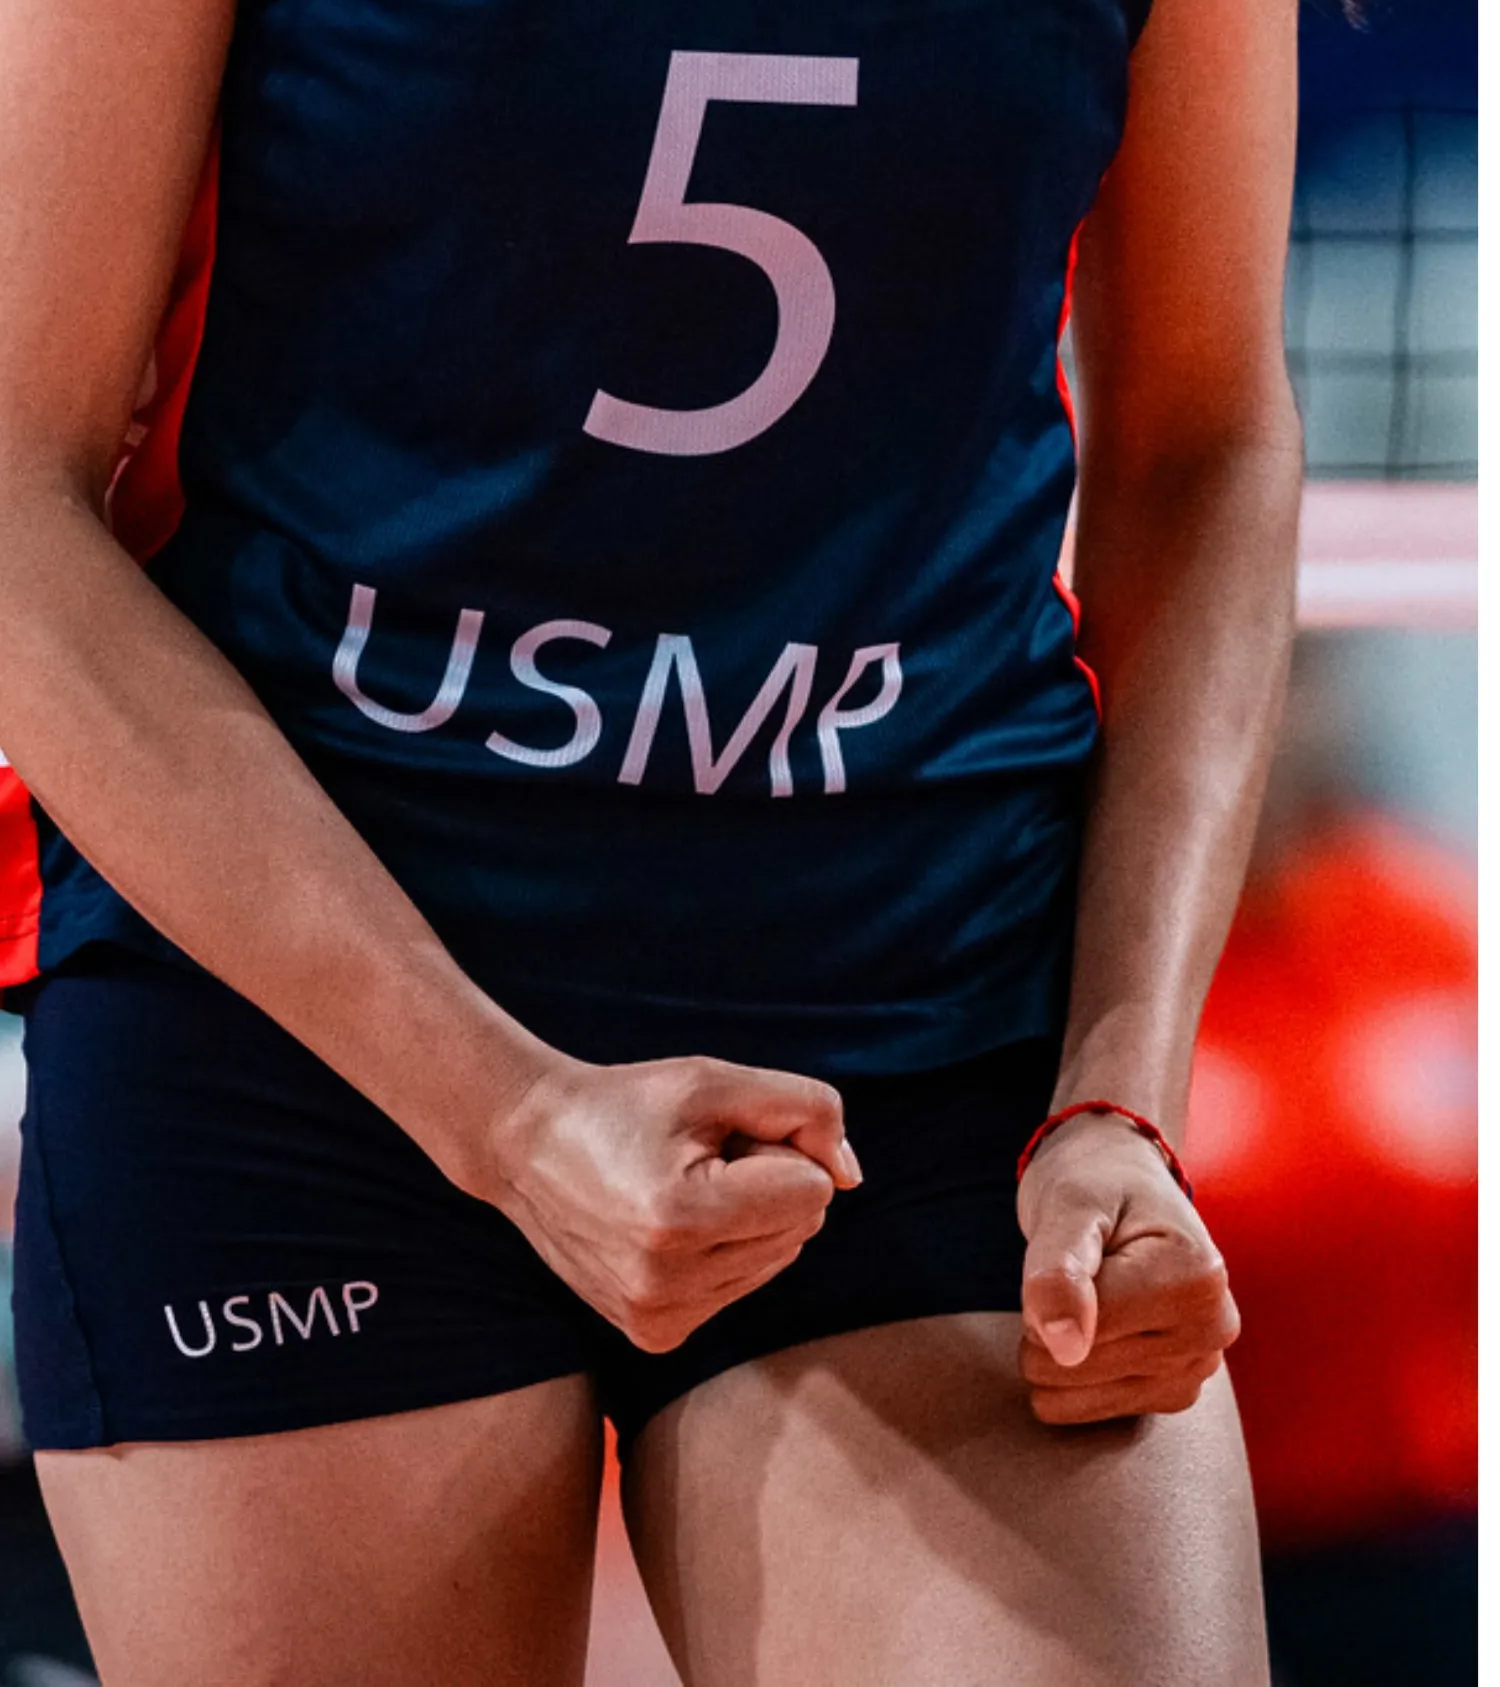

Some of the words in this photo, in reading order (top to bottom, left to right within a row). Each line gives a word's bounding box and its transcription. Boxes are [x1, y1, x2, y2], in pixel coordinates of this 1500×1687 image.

[581, 49, 861, 458] 5
[331, 584, 902, 798] USMP
[163, 1279, 380, 1359] USMP
